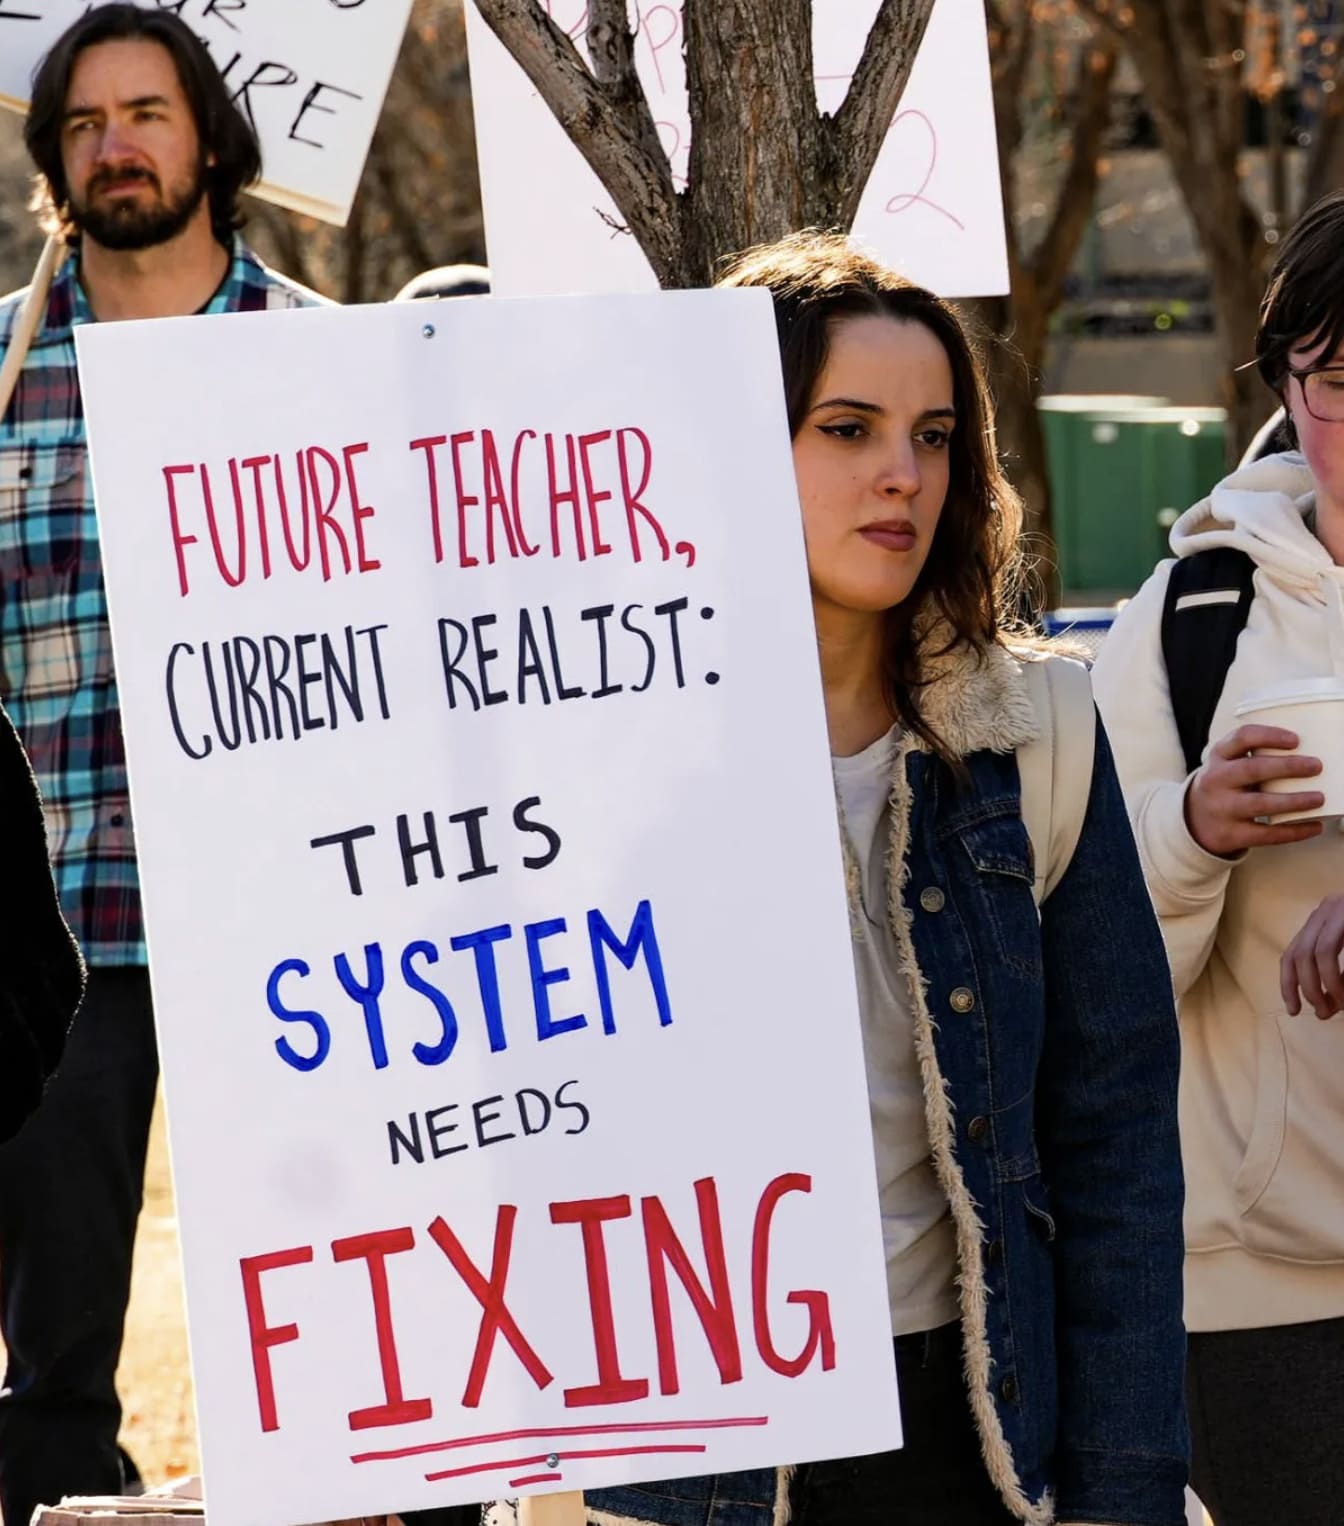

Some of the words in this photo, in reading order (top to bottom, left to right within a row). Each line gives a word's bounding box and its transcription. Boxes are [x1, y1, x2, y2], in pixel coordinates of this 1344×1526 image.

[163, 442, 381, 597] FUTURE
[410, 428, 697, 569] TEACHER,
[166, 622, 390, 761] CURRENT
[438, 597, 721, 712] REALIST:
[310, 796, 563, 896] THIS
[266, 899, 673, 1072] SYSTEM
[387, 1080, 591, 1165] NEEDS
[239, 1172, 837, 1433] FIXING
